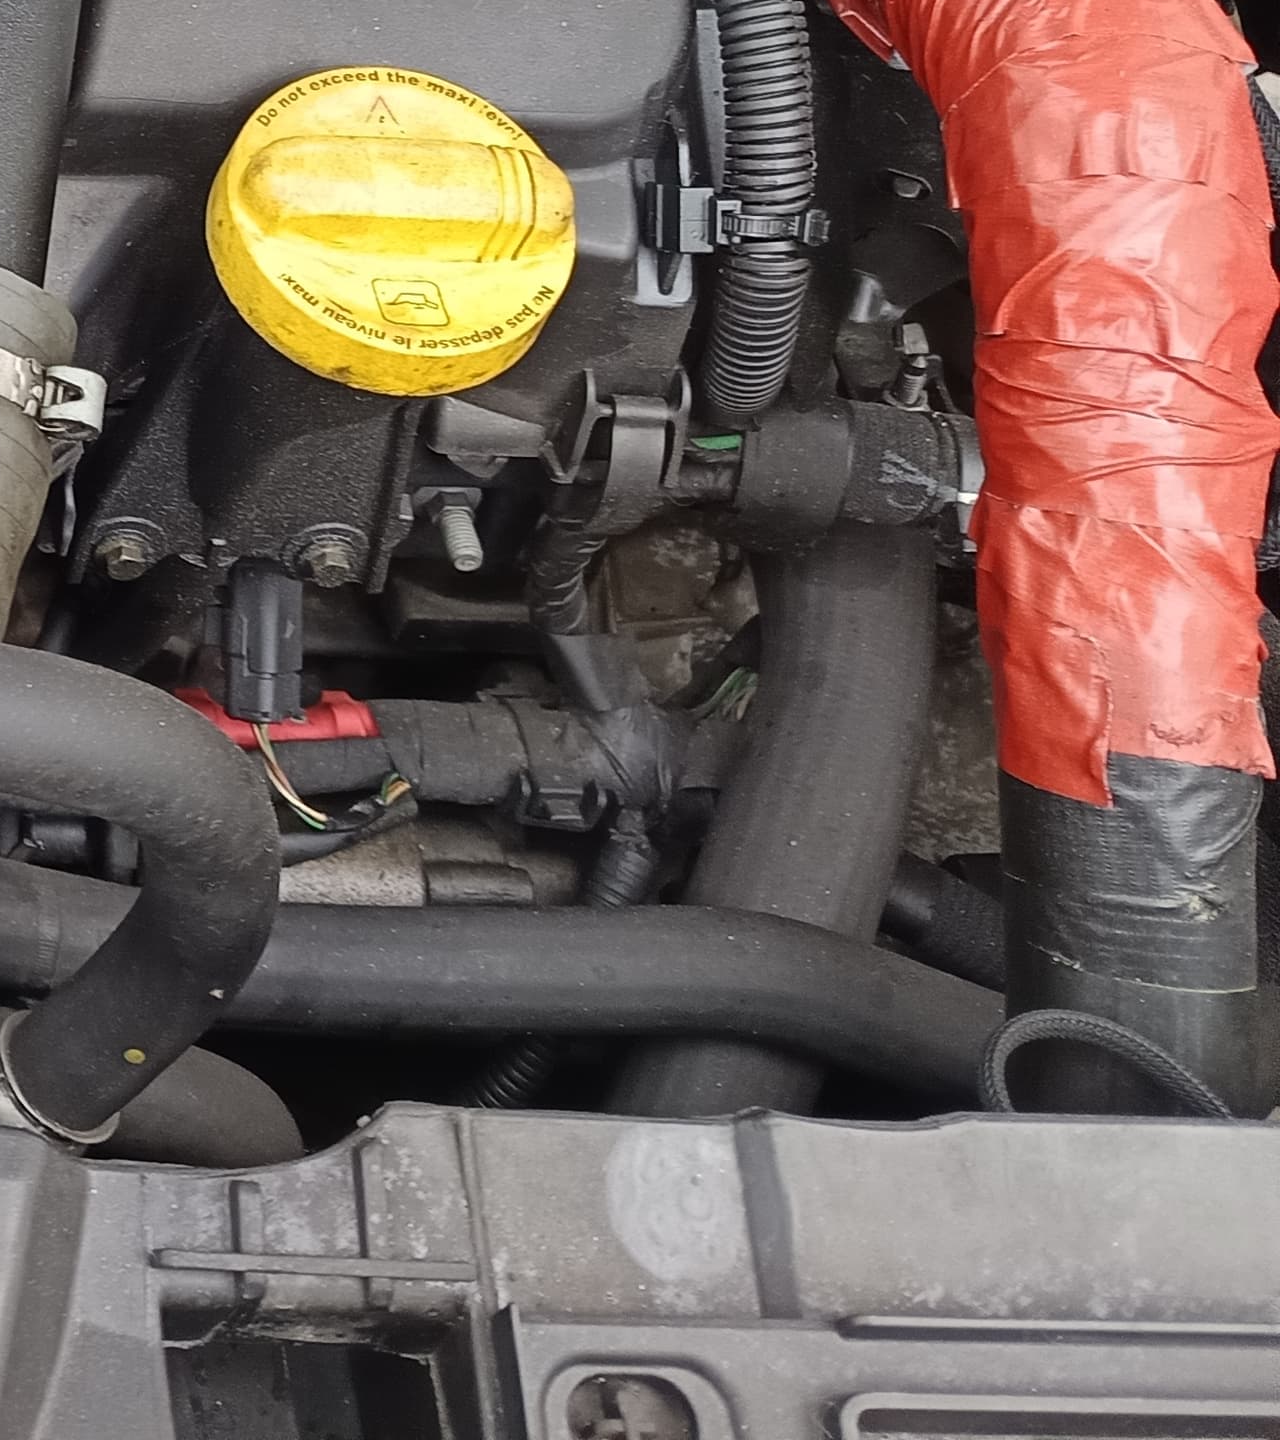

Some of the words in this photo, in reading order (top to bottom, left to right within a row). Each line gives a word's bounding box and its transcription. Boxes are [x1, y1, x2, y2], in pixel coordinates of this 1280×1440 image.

[256, 107, 278, 127] Do
[280, 86, 308, 109] not
[309, 70, 380, 92] exceed
[386, 71, 421, 87] the
[278, 273, 321, 308] maxi
[534, 284, 556, 307] Ne
[322, 305, 387, 343] niveau
[508, 304, 540, 330] pas
[392, 334, 412, 350] le
